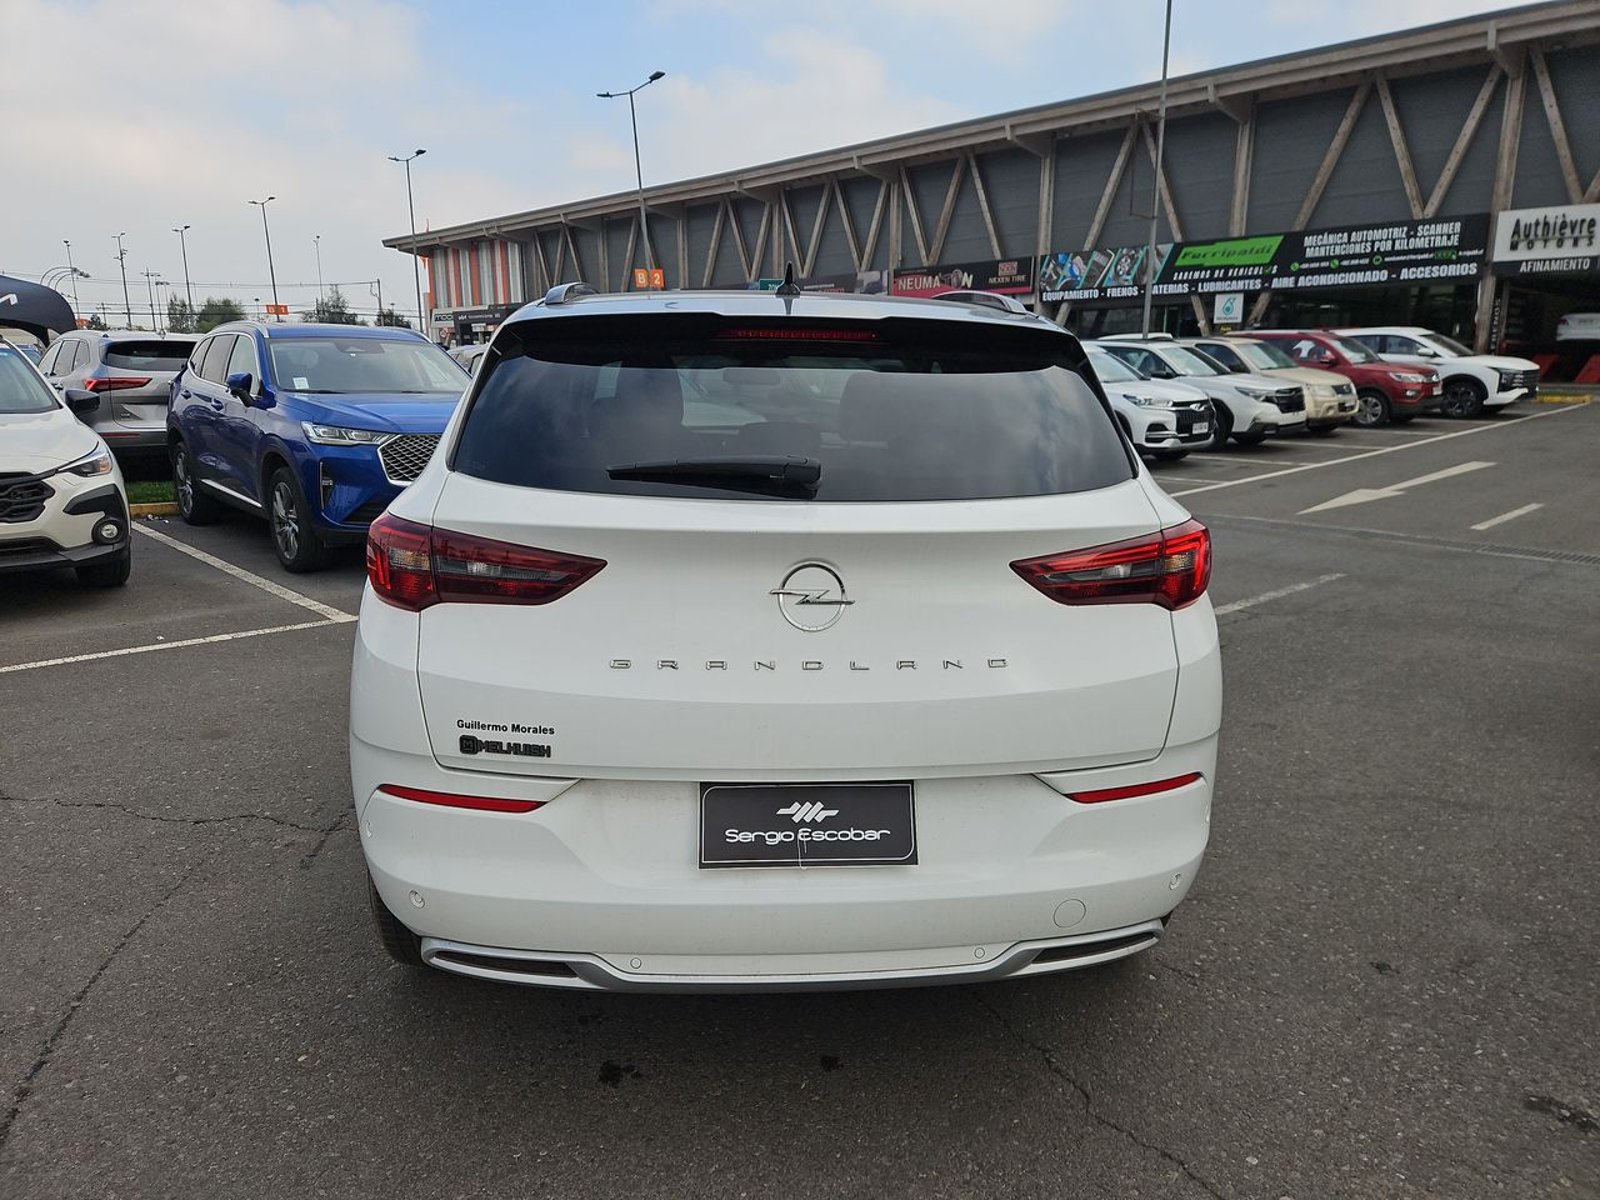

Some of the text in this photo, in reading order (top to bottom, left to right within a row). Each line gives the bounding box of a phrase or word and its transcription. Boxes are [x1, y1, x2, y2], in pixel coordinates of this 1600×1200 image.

[1350, 226, 1408, 242] AUTOMOTRIZ
[1417, 221, 1461, 237] SCANNER
[1511, 213, 1597, 239] Authièvre
[1306, 242, 1372, 258] MANTENCIONES
[1374, 240, 1392, 252] POR
[1394, 234, 1460, 250] KILOMETRAJE
[1510, 235, 1595, 251] MOTORS
[1228, 265, 1278, 277] VEHICULS
[1520, 258, 1591, 273] AFINAMIENTO
[1042, 289, 1099, 301] EQUIPAMIENTO
[1106, 286, 1138, 298] FRENOS
[1150, 282, 1190, 295] ATERIAS
[1198, 278, 1262, 292] LUBRICANTES
[1271, 276, 1296, 289] AIRE
[1297, 269, 1389, 287] ACONDICIONADO
[1400, 262, 1478, 280] ACCESORIOS
[609, 657, 1009, 671] GRANDLAND
[457, 719, 555, 735] Guillermo Morales
[725, 827, 891, 845] Sergio Escobar
